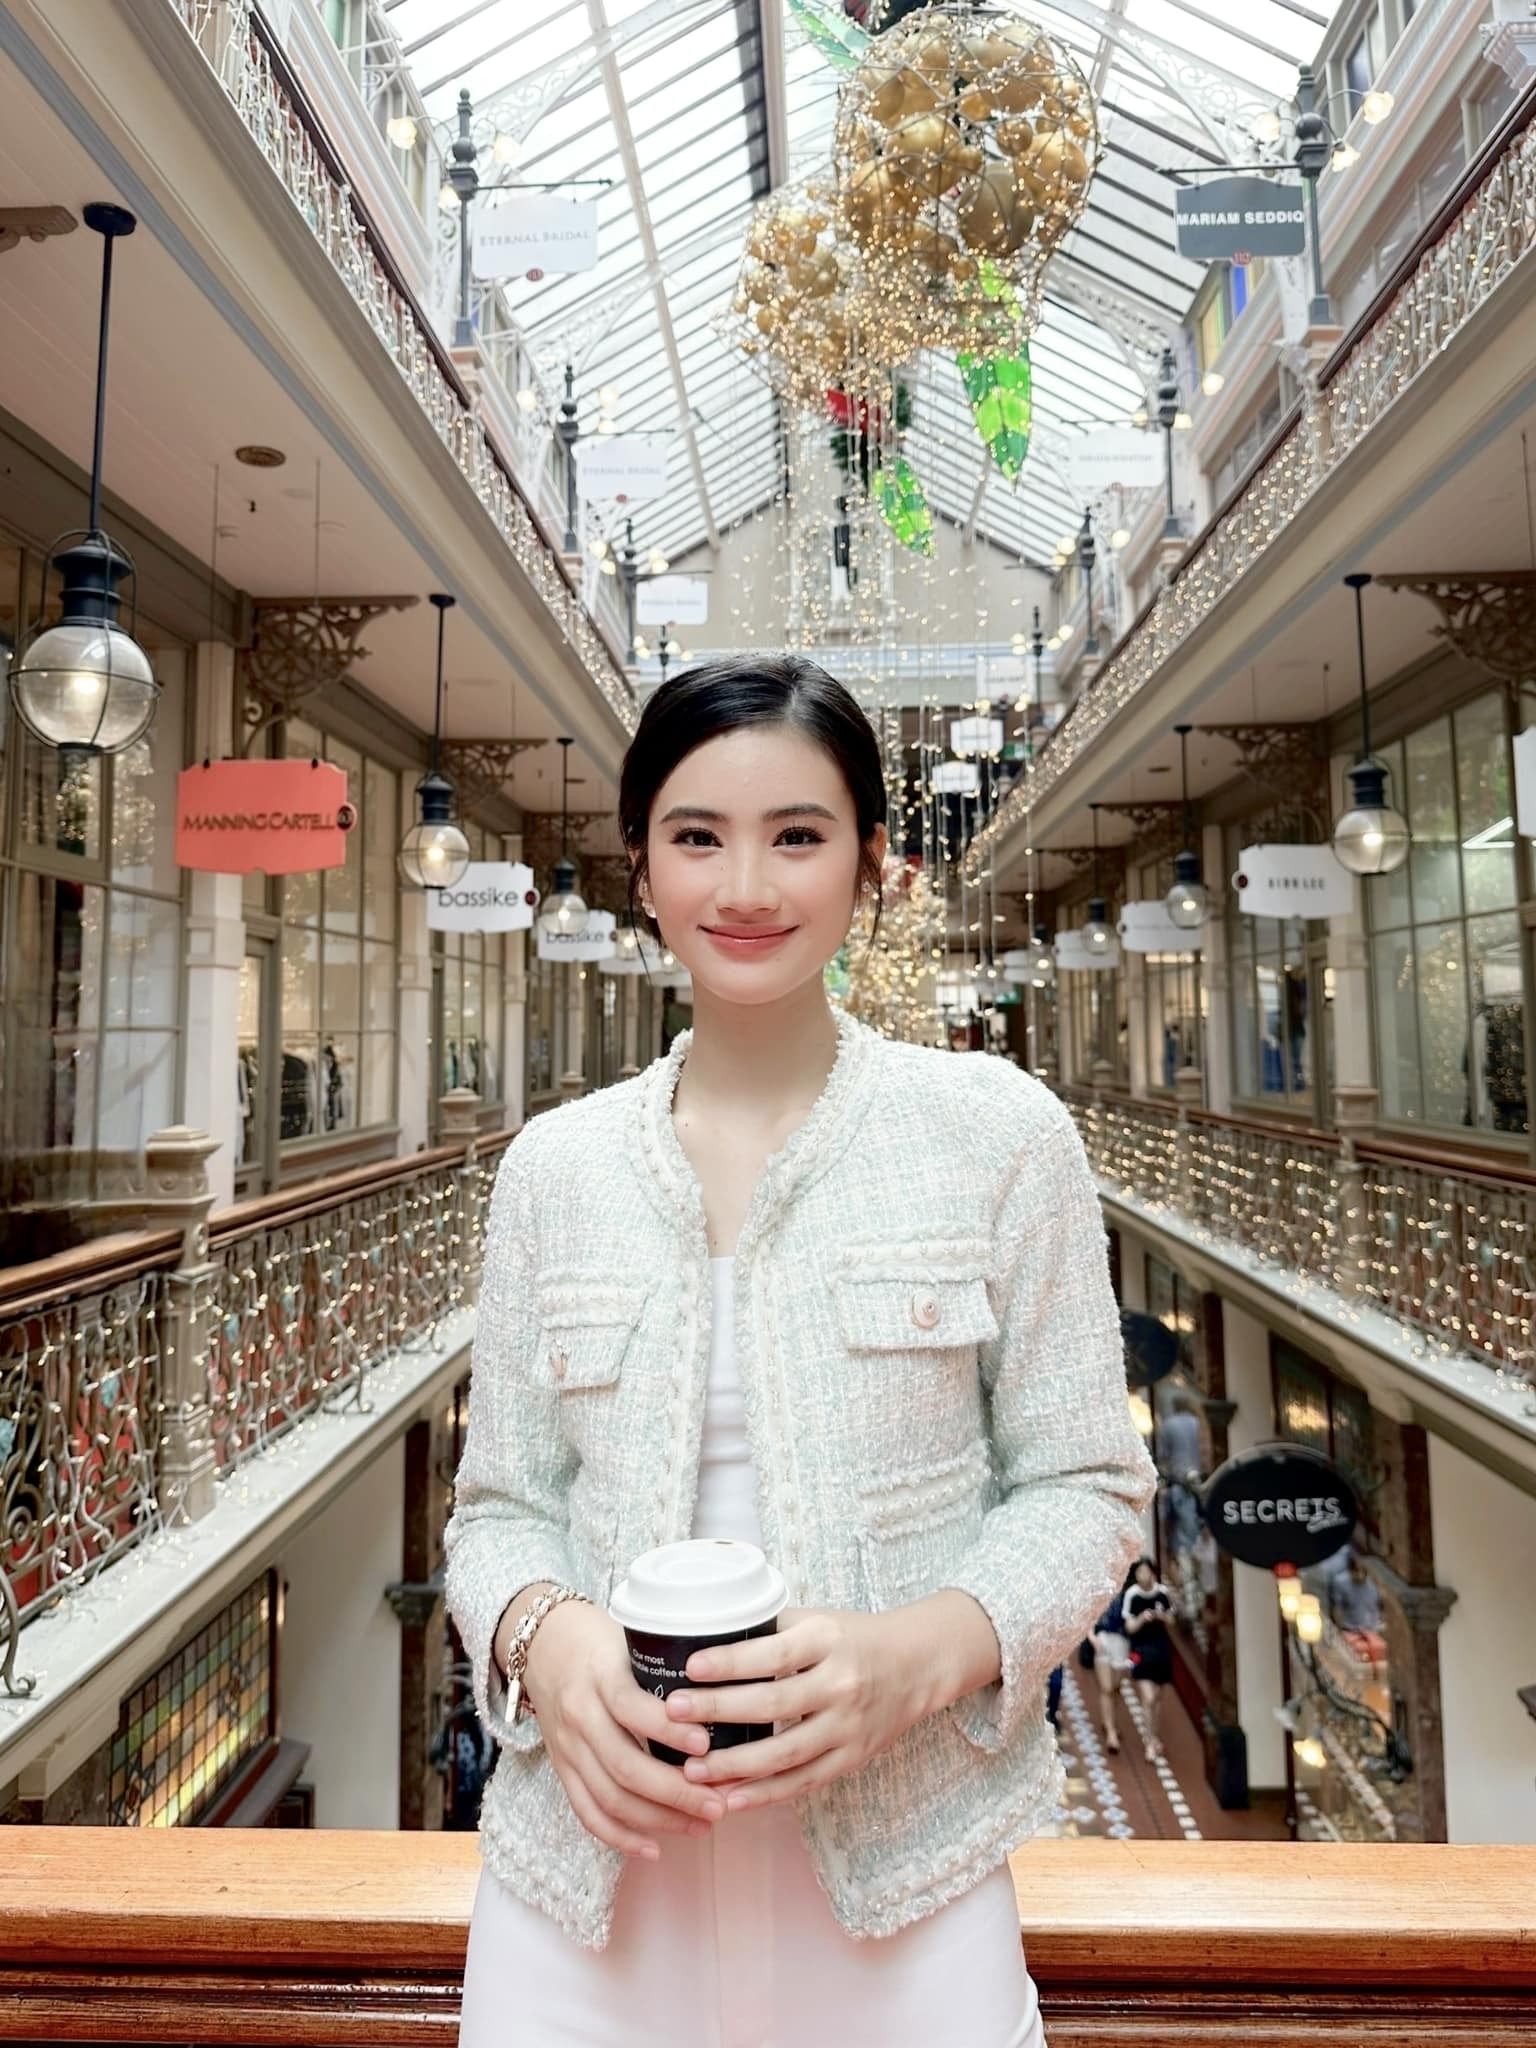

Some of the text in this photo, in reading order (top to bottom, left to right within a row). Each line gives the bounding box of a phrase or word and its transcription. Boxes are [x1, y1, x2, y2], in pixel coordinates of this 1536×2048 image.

[1176, 212, 1240, 226] MARIAM
[438, 887, 518, 908] bassike
[645, 1655, 665, 1665] most
[650, 1667, 677, 1678] coffee
